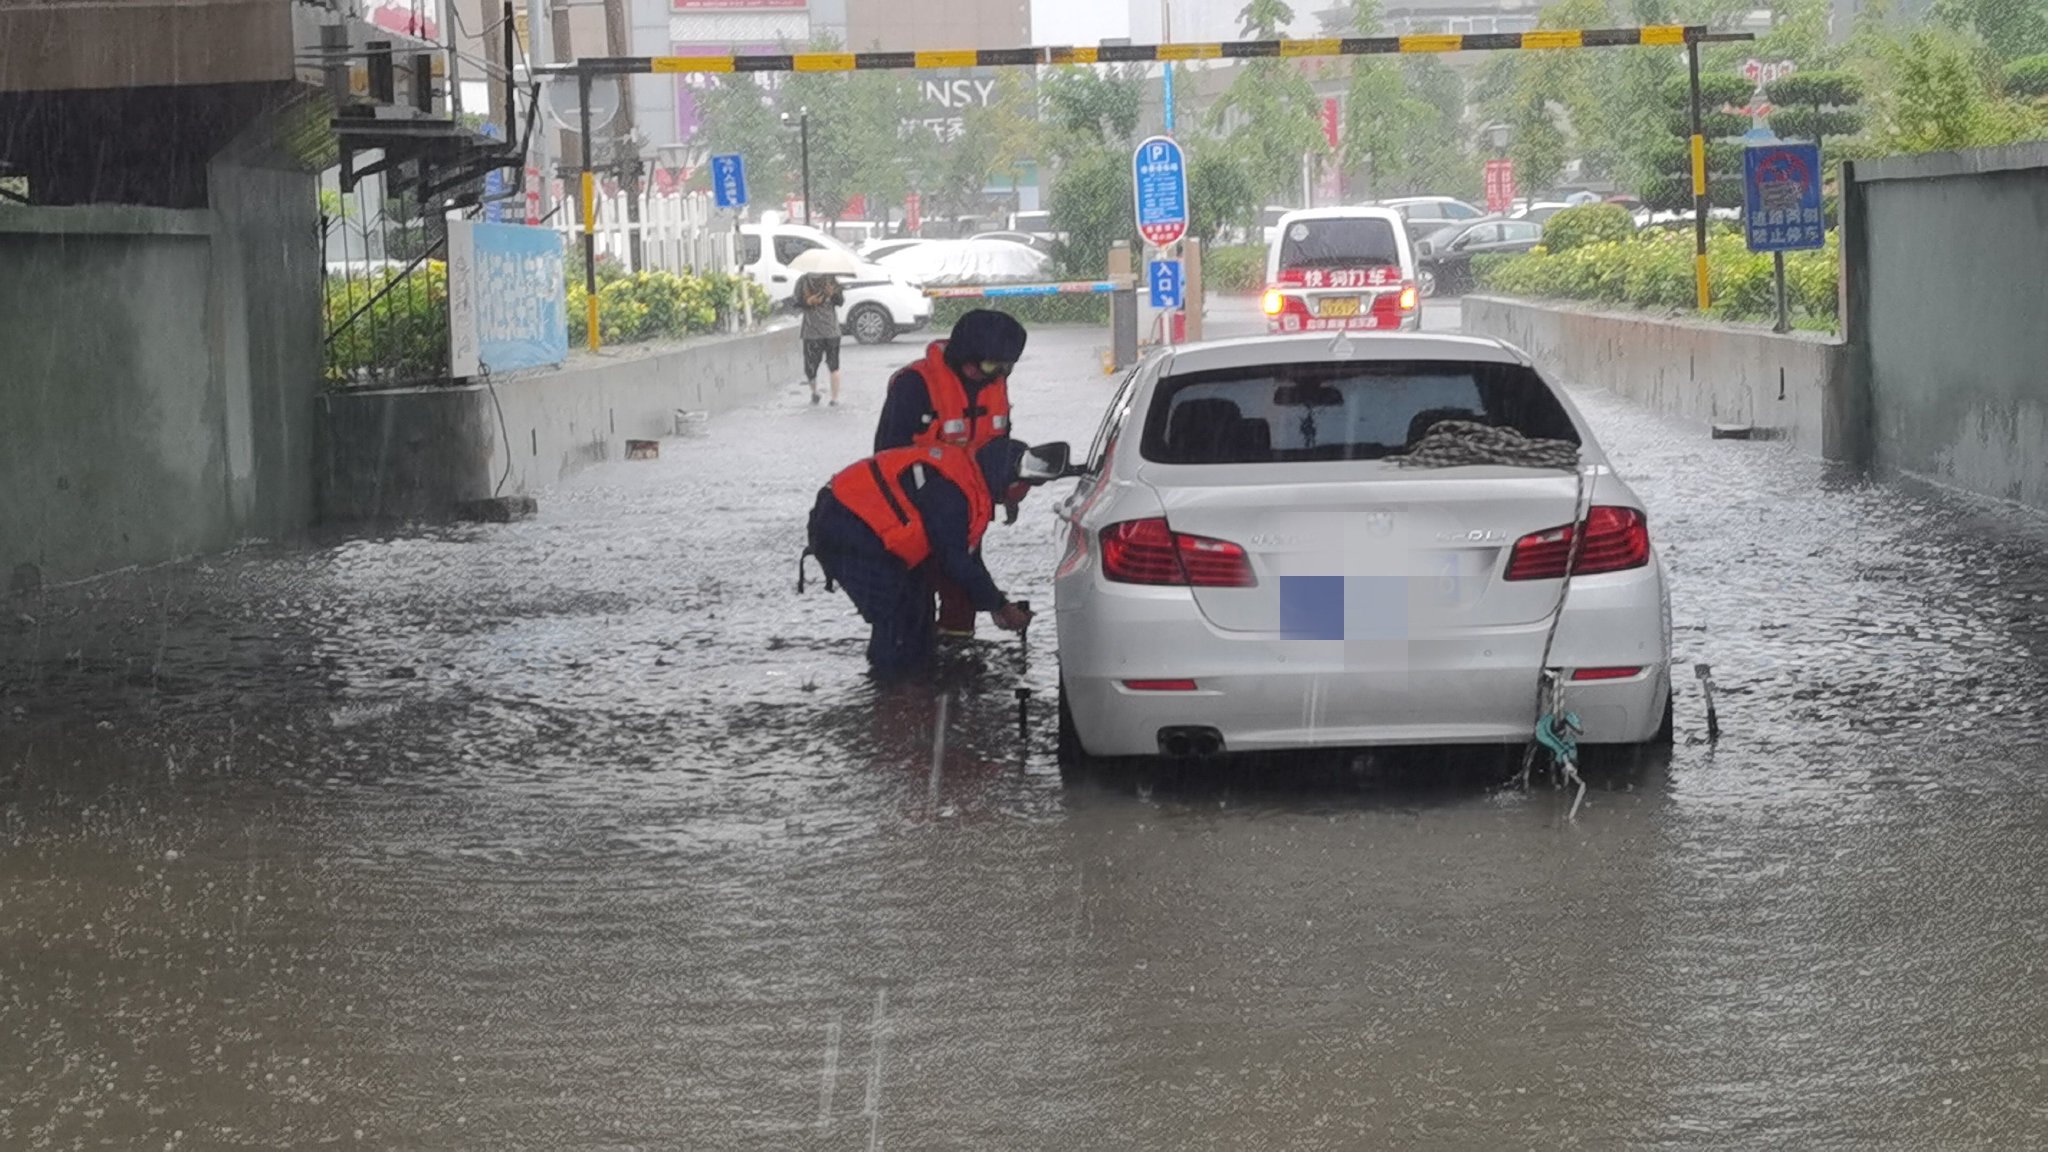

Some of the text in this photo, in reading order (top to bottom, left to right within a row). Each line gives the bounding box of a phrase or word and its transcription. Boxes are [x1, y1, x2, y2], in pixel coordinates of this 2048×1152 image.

[1156, 262, 1173, 292] 入口
[1304, 269, 1387, 287] 快狗打车
